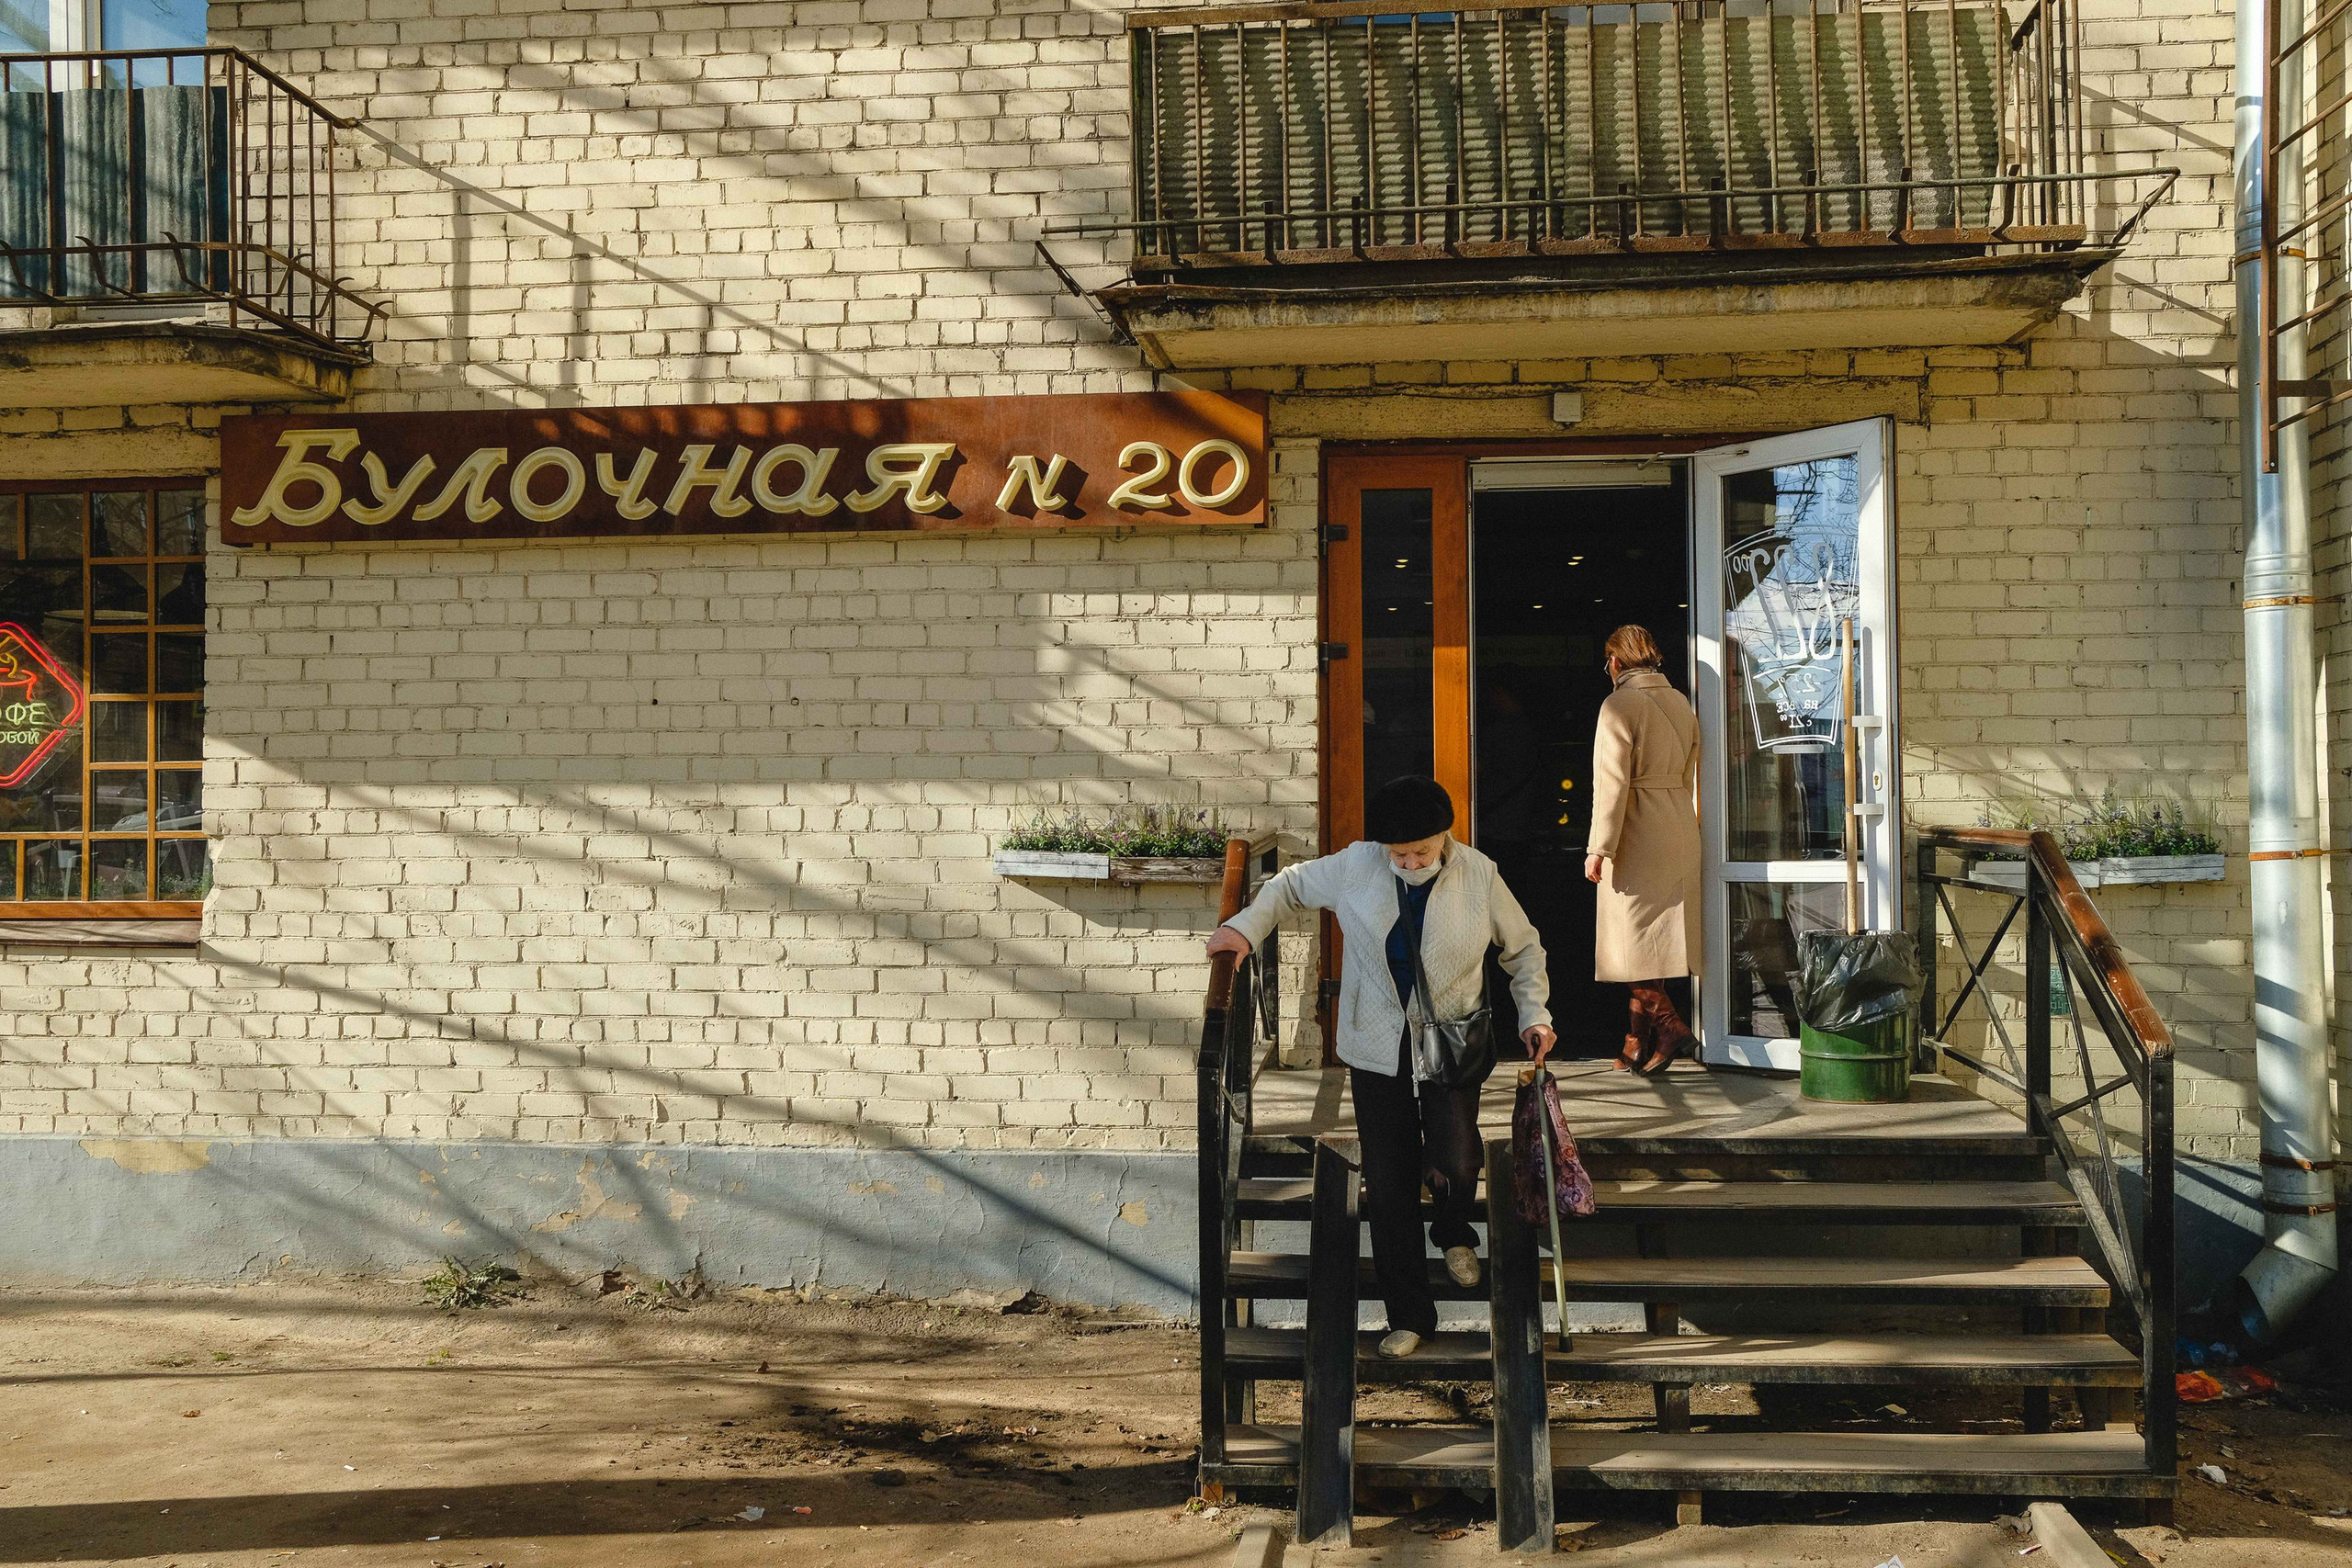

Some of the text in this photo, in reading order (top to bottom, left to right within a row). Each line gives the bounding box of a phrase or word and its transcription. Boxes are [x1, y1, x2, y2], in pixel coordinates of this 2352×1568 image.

[231, 428, 956, 527] Булочная
[1107, 438, 1250, 510] 20
[0, 702, 47, 726] ФЕ
